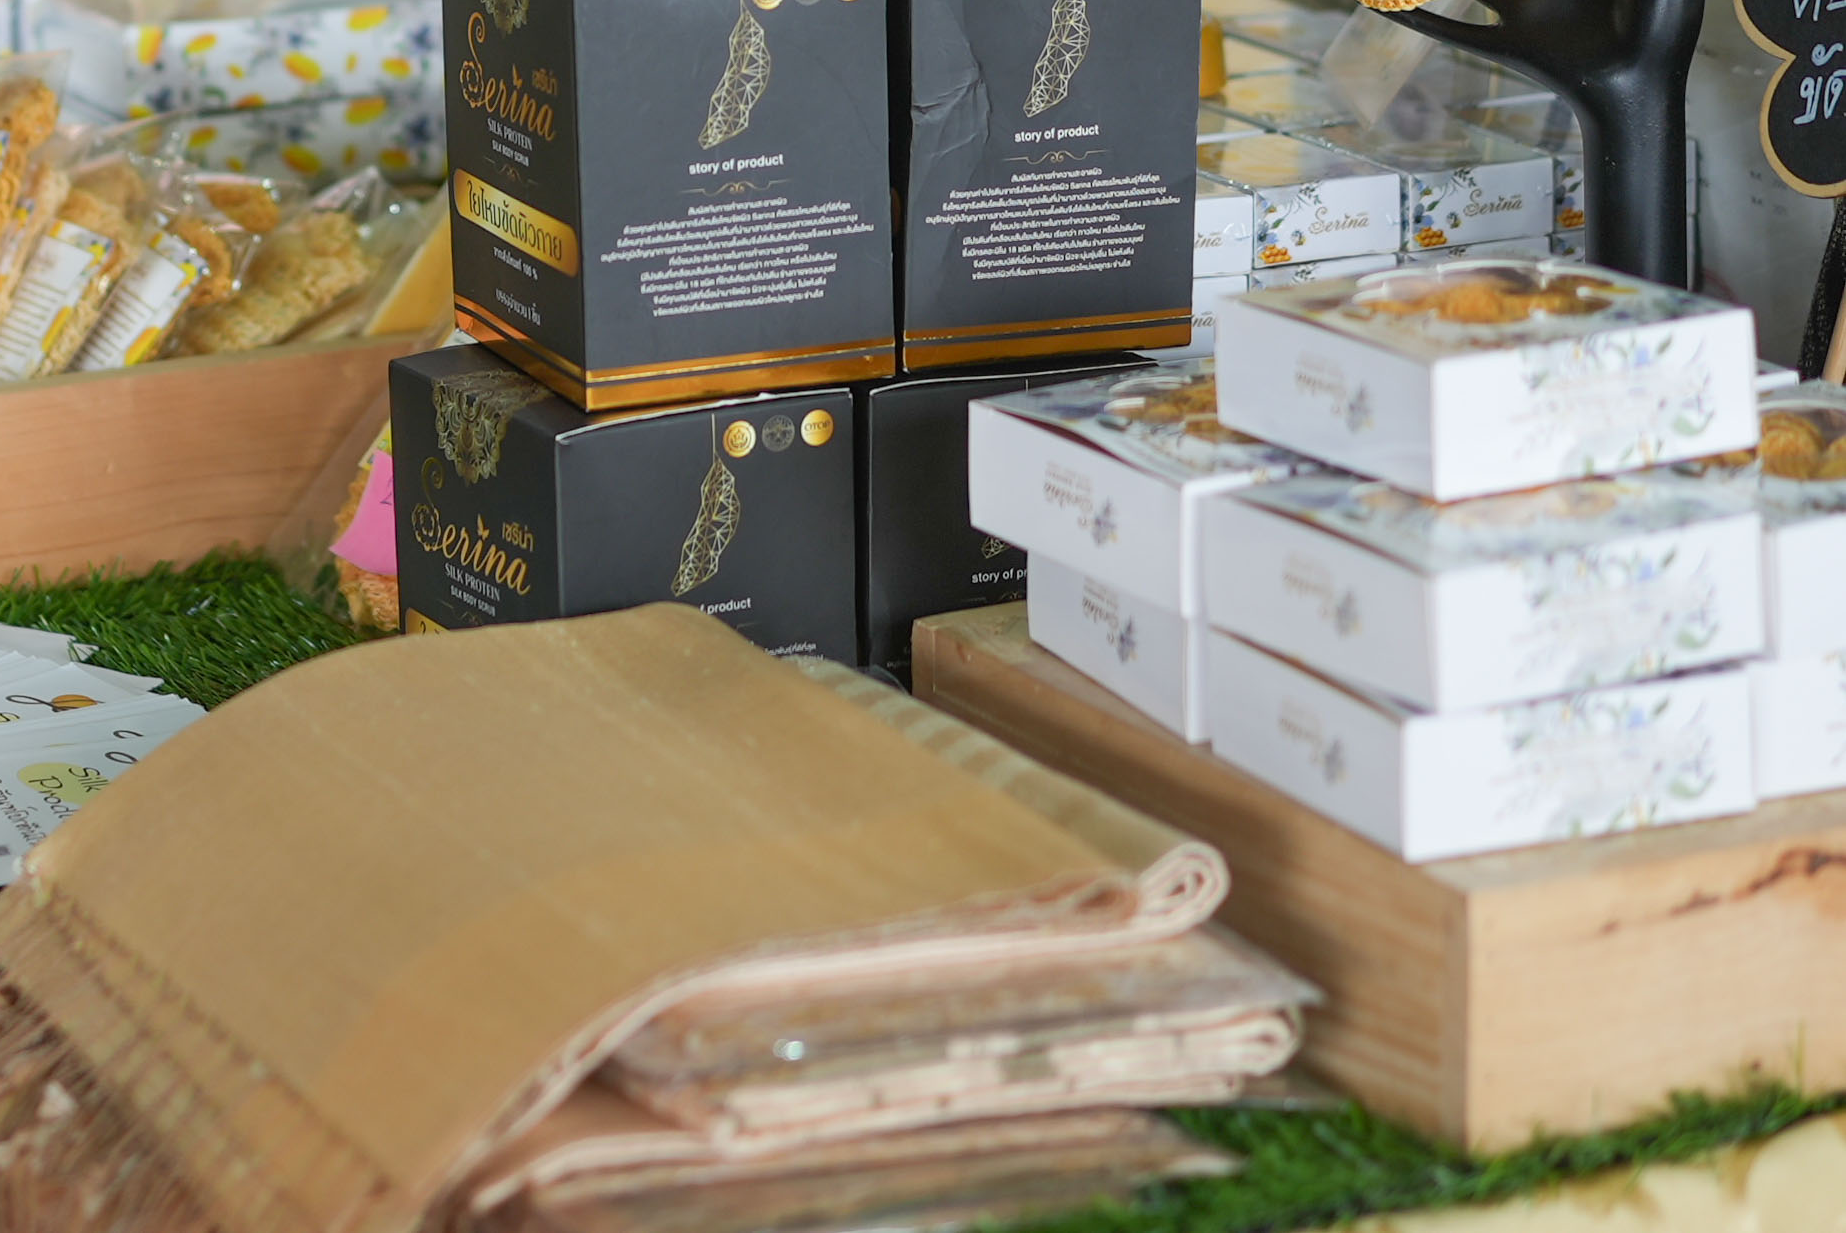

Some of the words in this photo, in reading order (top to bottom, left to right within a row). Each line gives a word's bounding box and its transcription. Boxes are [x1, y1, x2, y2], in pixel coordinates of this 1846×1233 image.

[487, 117, 503, 138] SILK
[503, 124, 533, 152] PROTEIN
[1015, 129, 1042, 144] story
[1043, 127, 1055, 140] of
[1057, 123, 1100, 141] product
[688, 160, 720, 176] story
[721, 157, 735, 172] of
[736, 153, 785, 172] product
[1463, 189, 1523, 218] Serina
[466, 179, 564, 262] ใยไหมขัดผิวกาย
[1307, 206, 1370, 236] Serina
[411, 457, 531, 596] Serina
[445, 562, 464, 583] SILK
[464, 571, 501, 602] PROTEIN
[971, 570, 1000, 585] story
[1002, 567, 1015, 580] of
[462, 590, 477, 608] BODY
[707, 597, 752, 615] product
[68, 766, 109, 793] Silk
[28, 775, 81, 819] Prod
